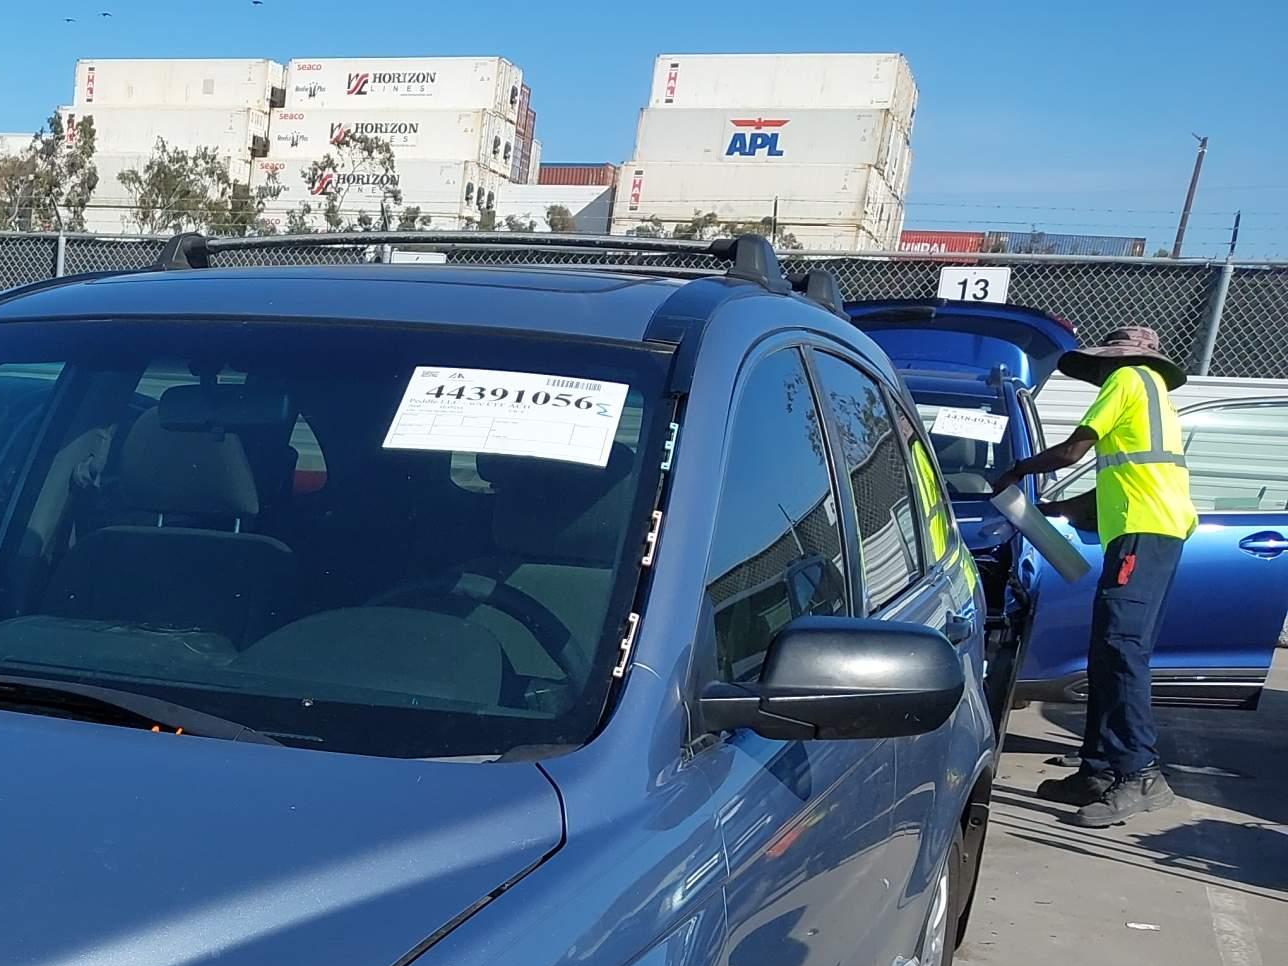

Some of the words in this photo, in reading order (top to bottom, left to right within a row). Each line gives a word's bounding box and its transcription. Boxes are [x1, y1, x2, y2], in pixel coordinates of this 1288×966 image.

[297, 63, 322, 71] seaco
[372, 72, 436, 84] HORIZON
[279, 112, 304, 120] seaco
[355, 122, 419, 134] HORIZON
[725, 133, 785, 157] APL
[259, 161, 285, 170] seaco
[337, 174, 400, 185] HORIZON
[957, 278, 990, 301] 13
[425, 384, 593, 410] 44391056
